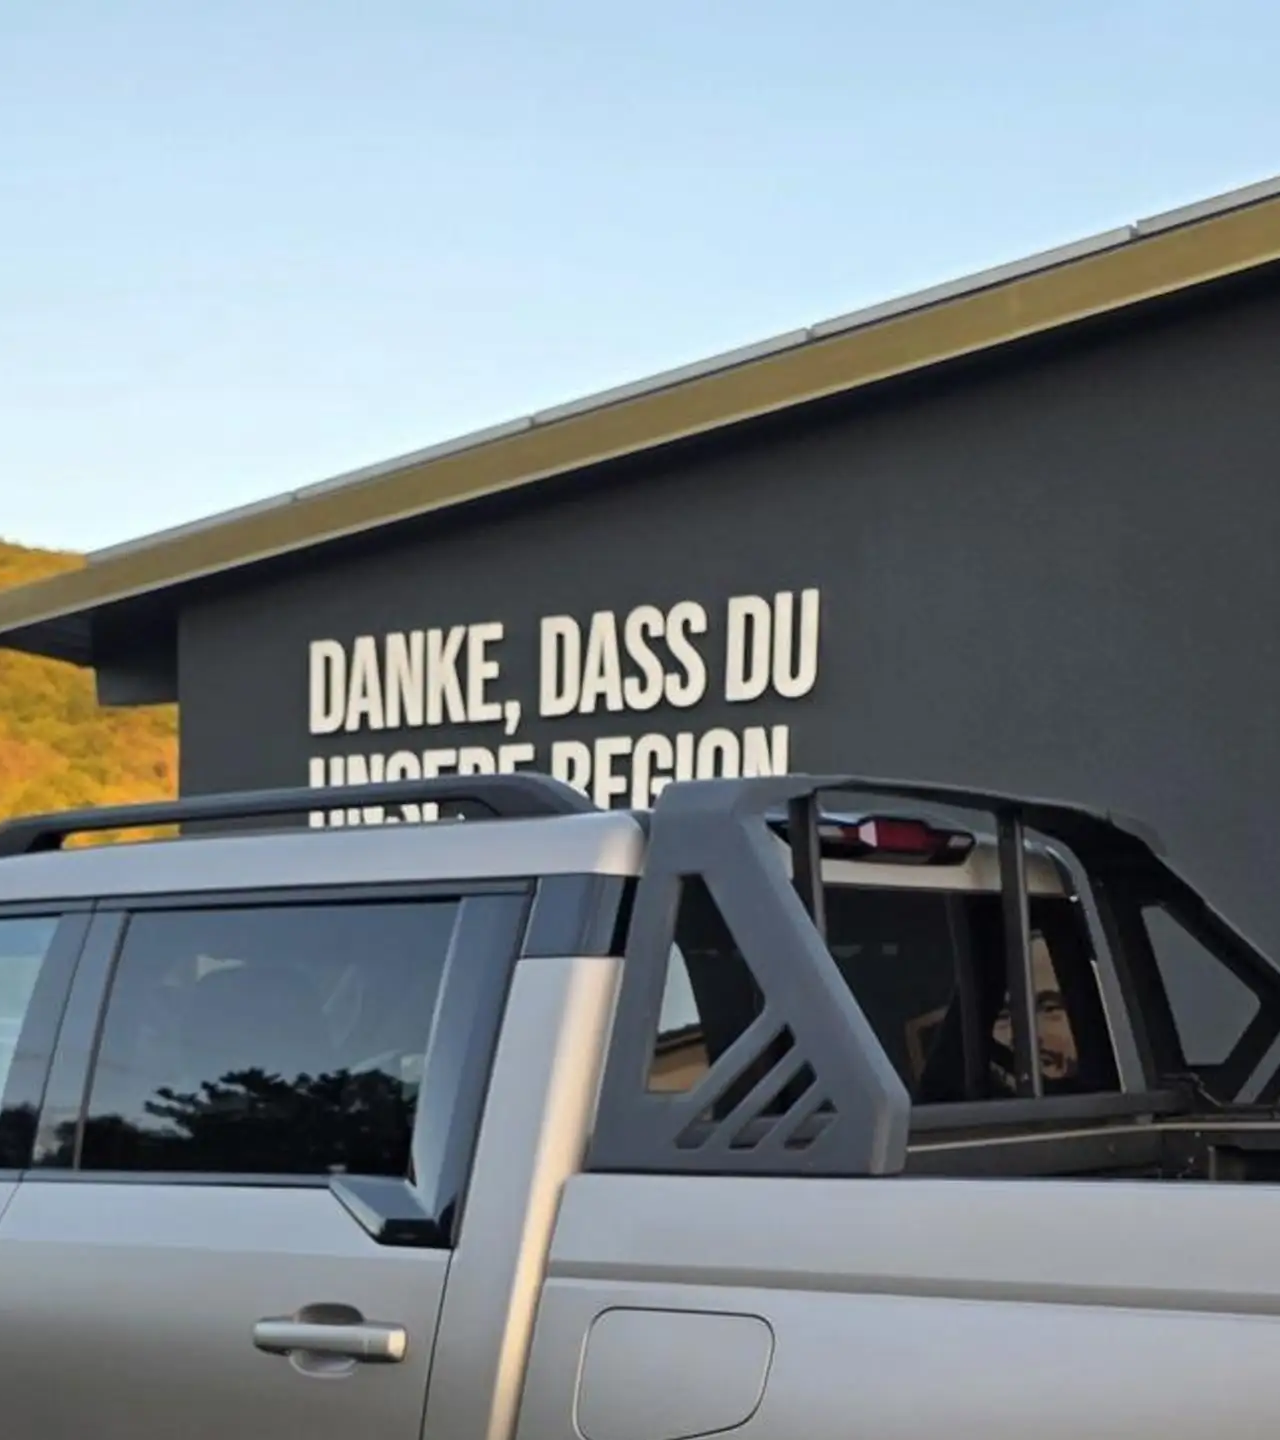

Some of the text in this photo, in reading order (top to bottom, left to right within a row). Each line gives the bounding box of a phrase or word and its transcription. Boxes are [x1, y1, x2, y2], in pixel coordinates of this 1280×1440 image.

[309, 588, 819, 735] DANKE, DASS DU
